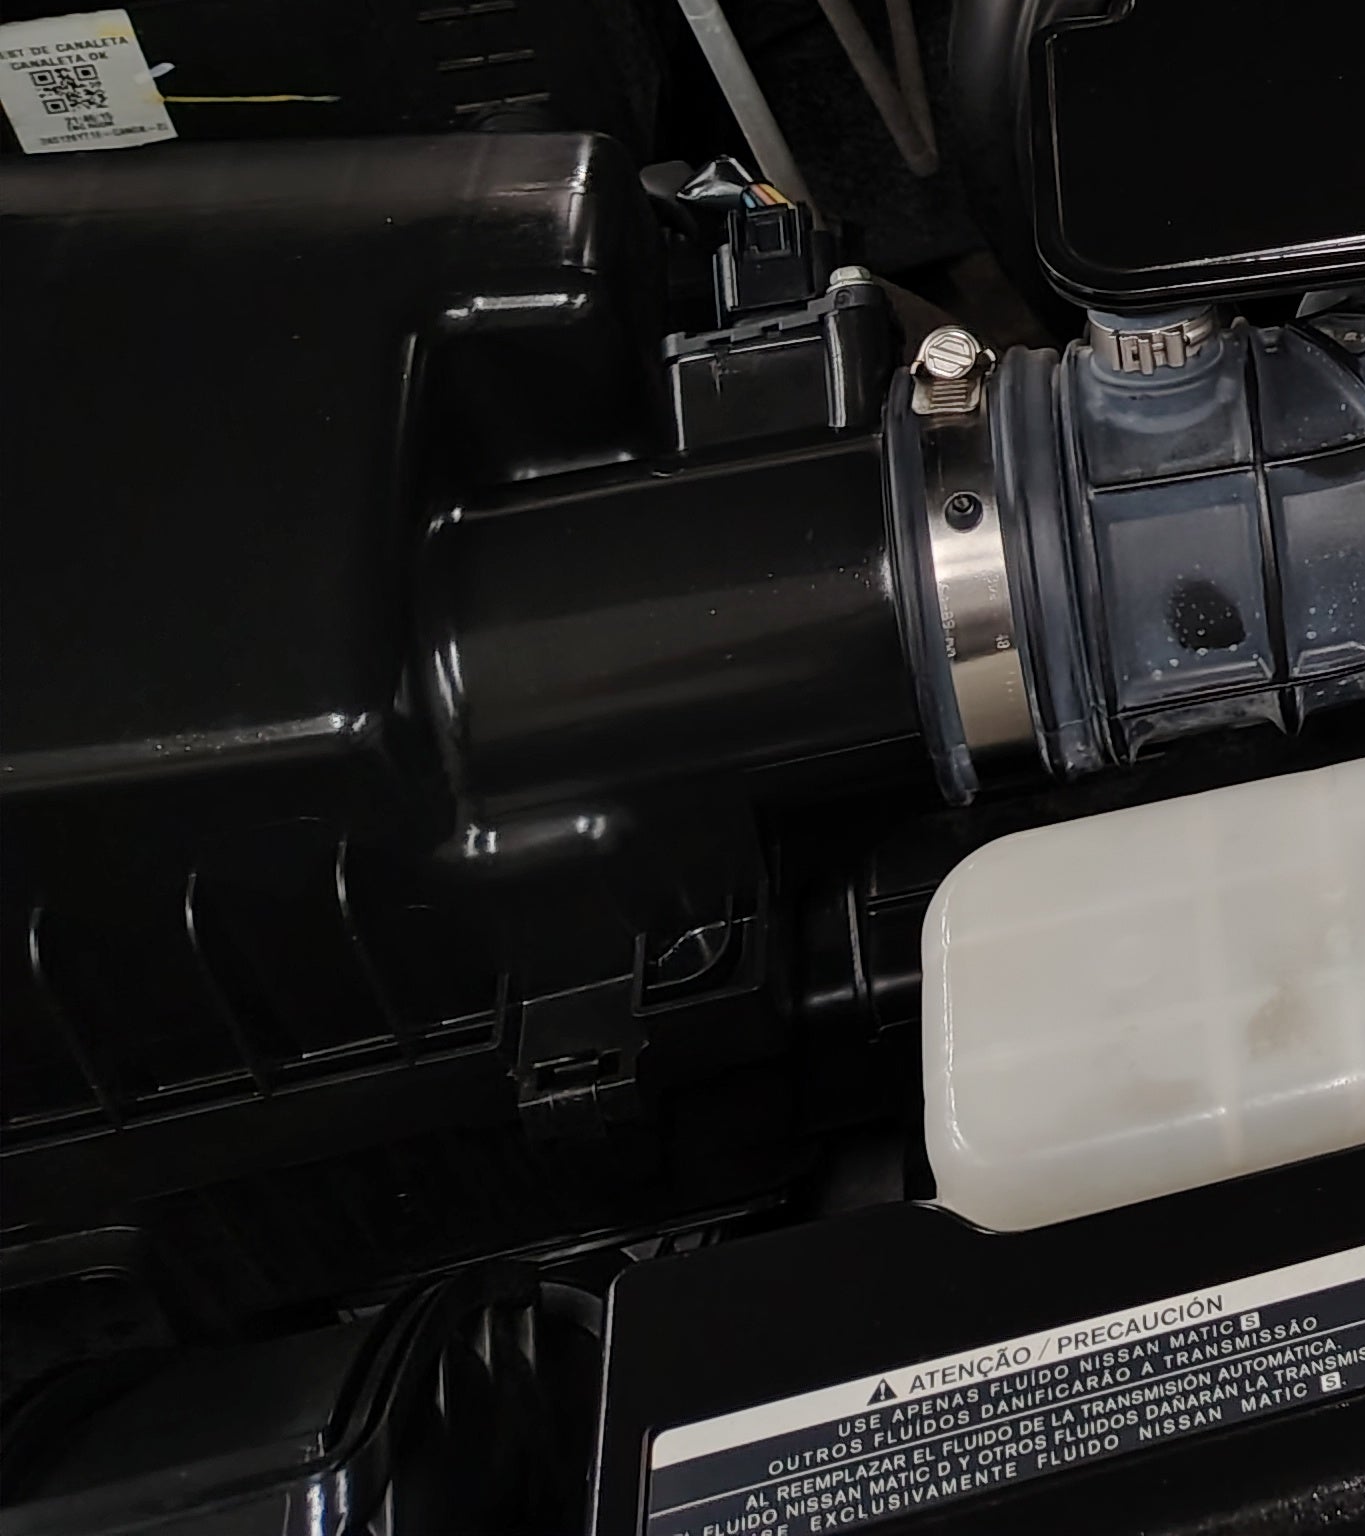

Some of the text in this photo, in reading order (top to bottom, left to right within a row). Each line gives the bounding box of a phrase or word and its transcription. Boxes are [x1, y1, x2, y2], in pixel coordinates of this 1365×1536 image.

[10, 51, 108, 71] CANALETA OK
[55, 36, 129, 53] CANALETA
[768, 1316, 1318, 1476] OUTROS FLUÍDOS DANIFICARÃO A TRANSMISSÃO
[838, 1414, 882, 1439] USE
[891, 1388, 979, 1423] APENAS
[989, 1364, 1069, 1398] FLUÍDO
[1079, 1339, 1160, 1373] NISSAN
[1169, 1320, 1234, 1349] MATIC
[908, 1345, 1031, 1394] ATENÇÃO
[1056, 1294, 1224, 1355] PRECAUCIÓN
[702, 1508, 778, 1536] FLUIDO
[785, 1480, 861, 1519] NISSAN
[869, 1461, 930, 1497] MATIC
[937, 1461, 951, 1477] D
[959, 1455, 971, 1471] Y
[978, 1435, 1047, 1465] OTROS
[1054, 1410, 1139, 1445] FLUIDOS
[1145, 1382, 1240, 1420] DAÑARÁN
[1245, 1375, 1269, 1393] LA
[745, 1336, 1342, 1511] AL REEMPLAZAR EL FLUIDO DE LA TRANSMISIÓN AUTOMÁTICA.
[809, 1463, 1018, 1531] EXCLUSIVAMENTE
[1037, 1434, 1120, 1469] FLUIDO
[1138, 1406, 1223, 1441] NISSAN
[1240, 1382, 1308, 1414] MATIC
